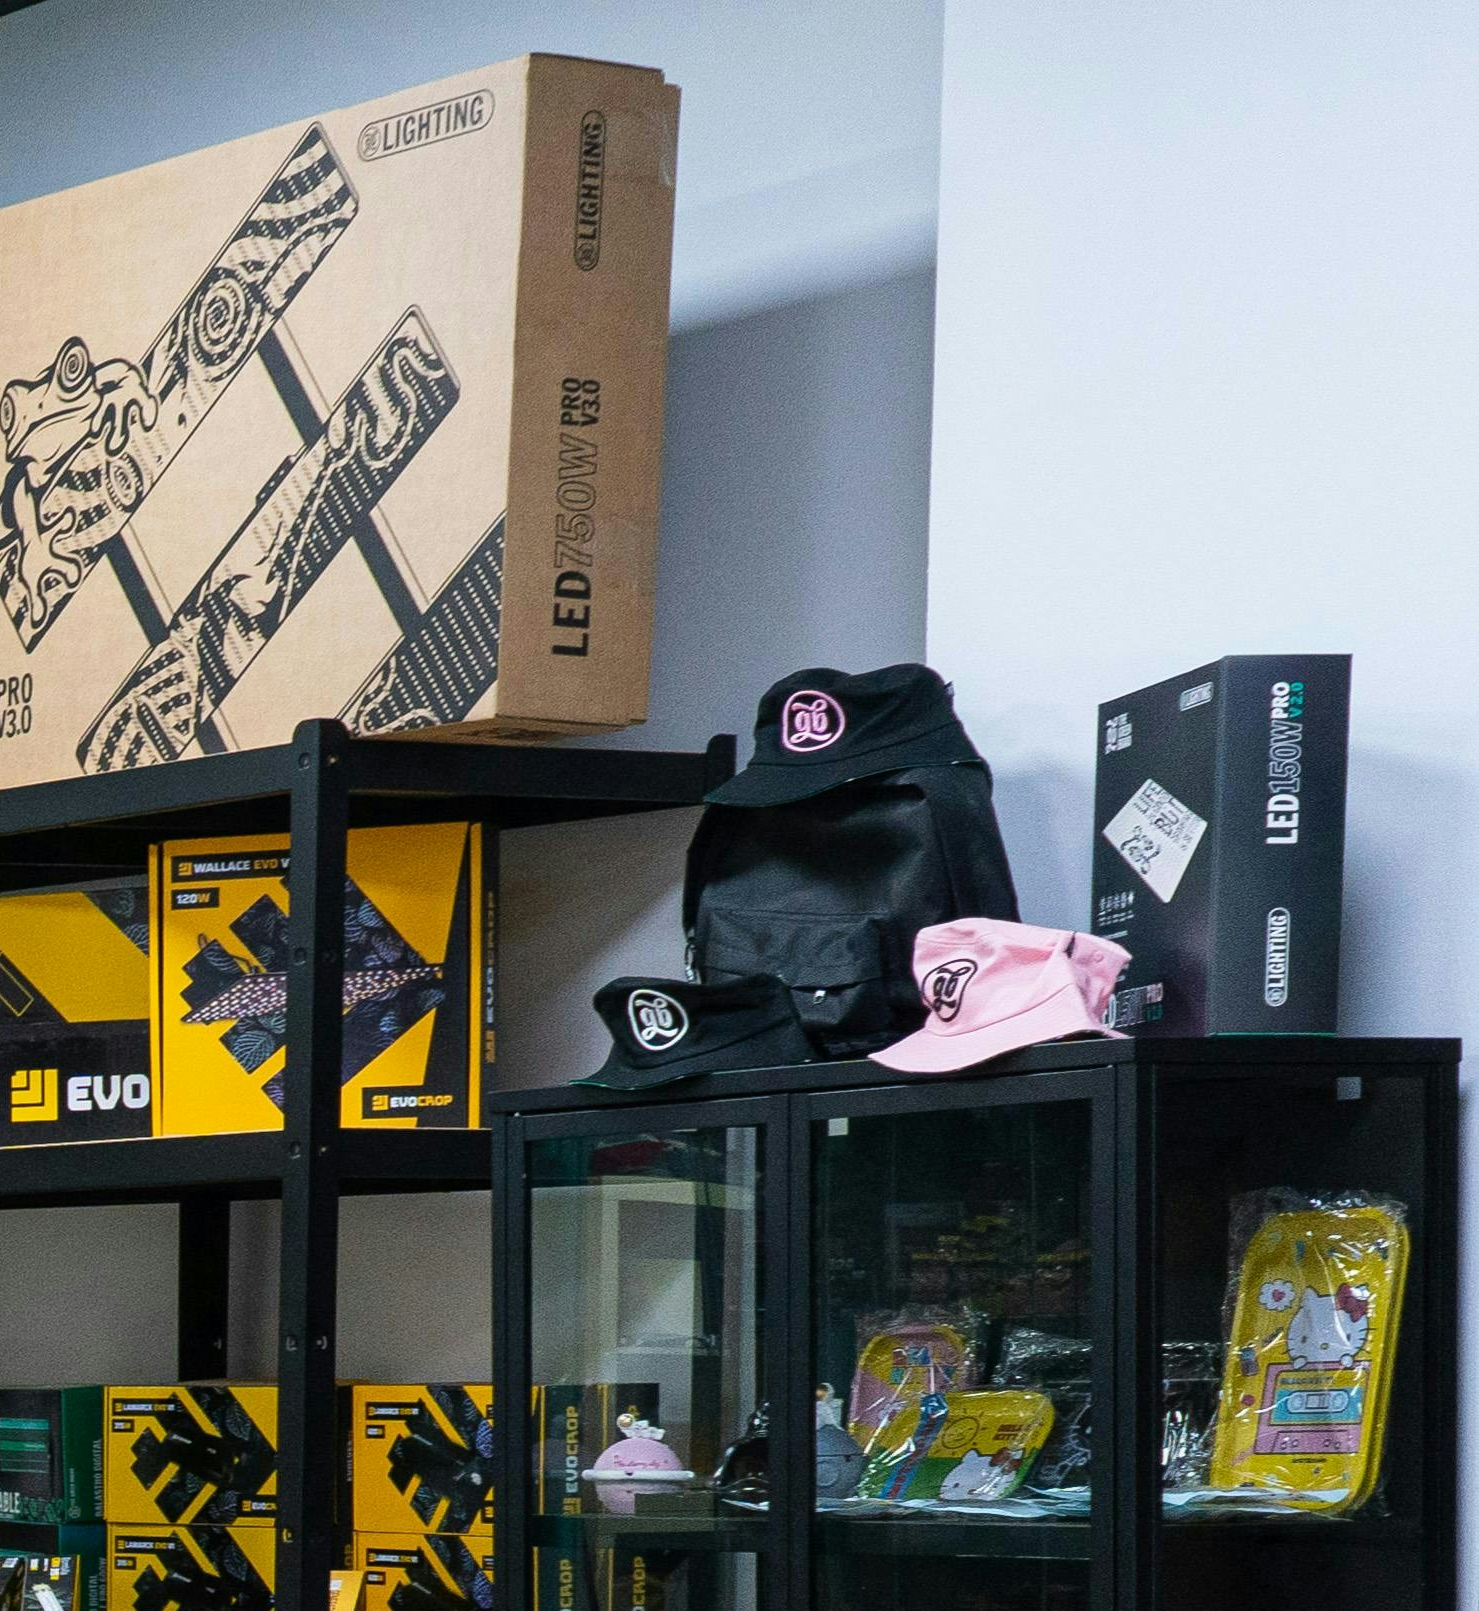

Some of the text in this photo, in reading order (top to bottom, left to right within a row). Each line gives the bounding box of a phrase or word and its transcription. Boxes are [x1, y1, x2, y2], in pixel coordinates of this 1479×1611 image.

[383, 96, 484, 151] LIGHTING
[579, 122, 601, 241] LIGHTING
[560, 377, 581, 426] PRO
[580, 379, 601, 427] V3.0
[1271, 681, 1290, 719] PRO
[176, 892, 210, 904] 120W
[1268, 912, 1288, 989] LIGHTING
[389, 1094, 453, 1109] EVOCROP
[565, 1405, 580, 1495] EVOCROP
